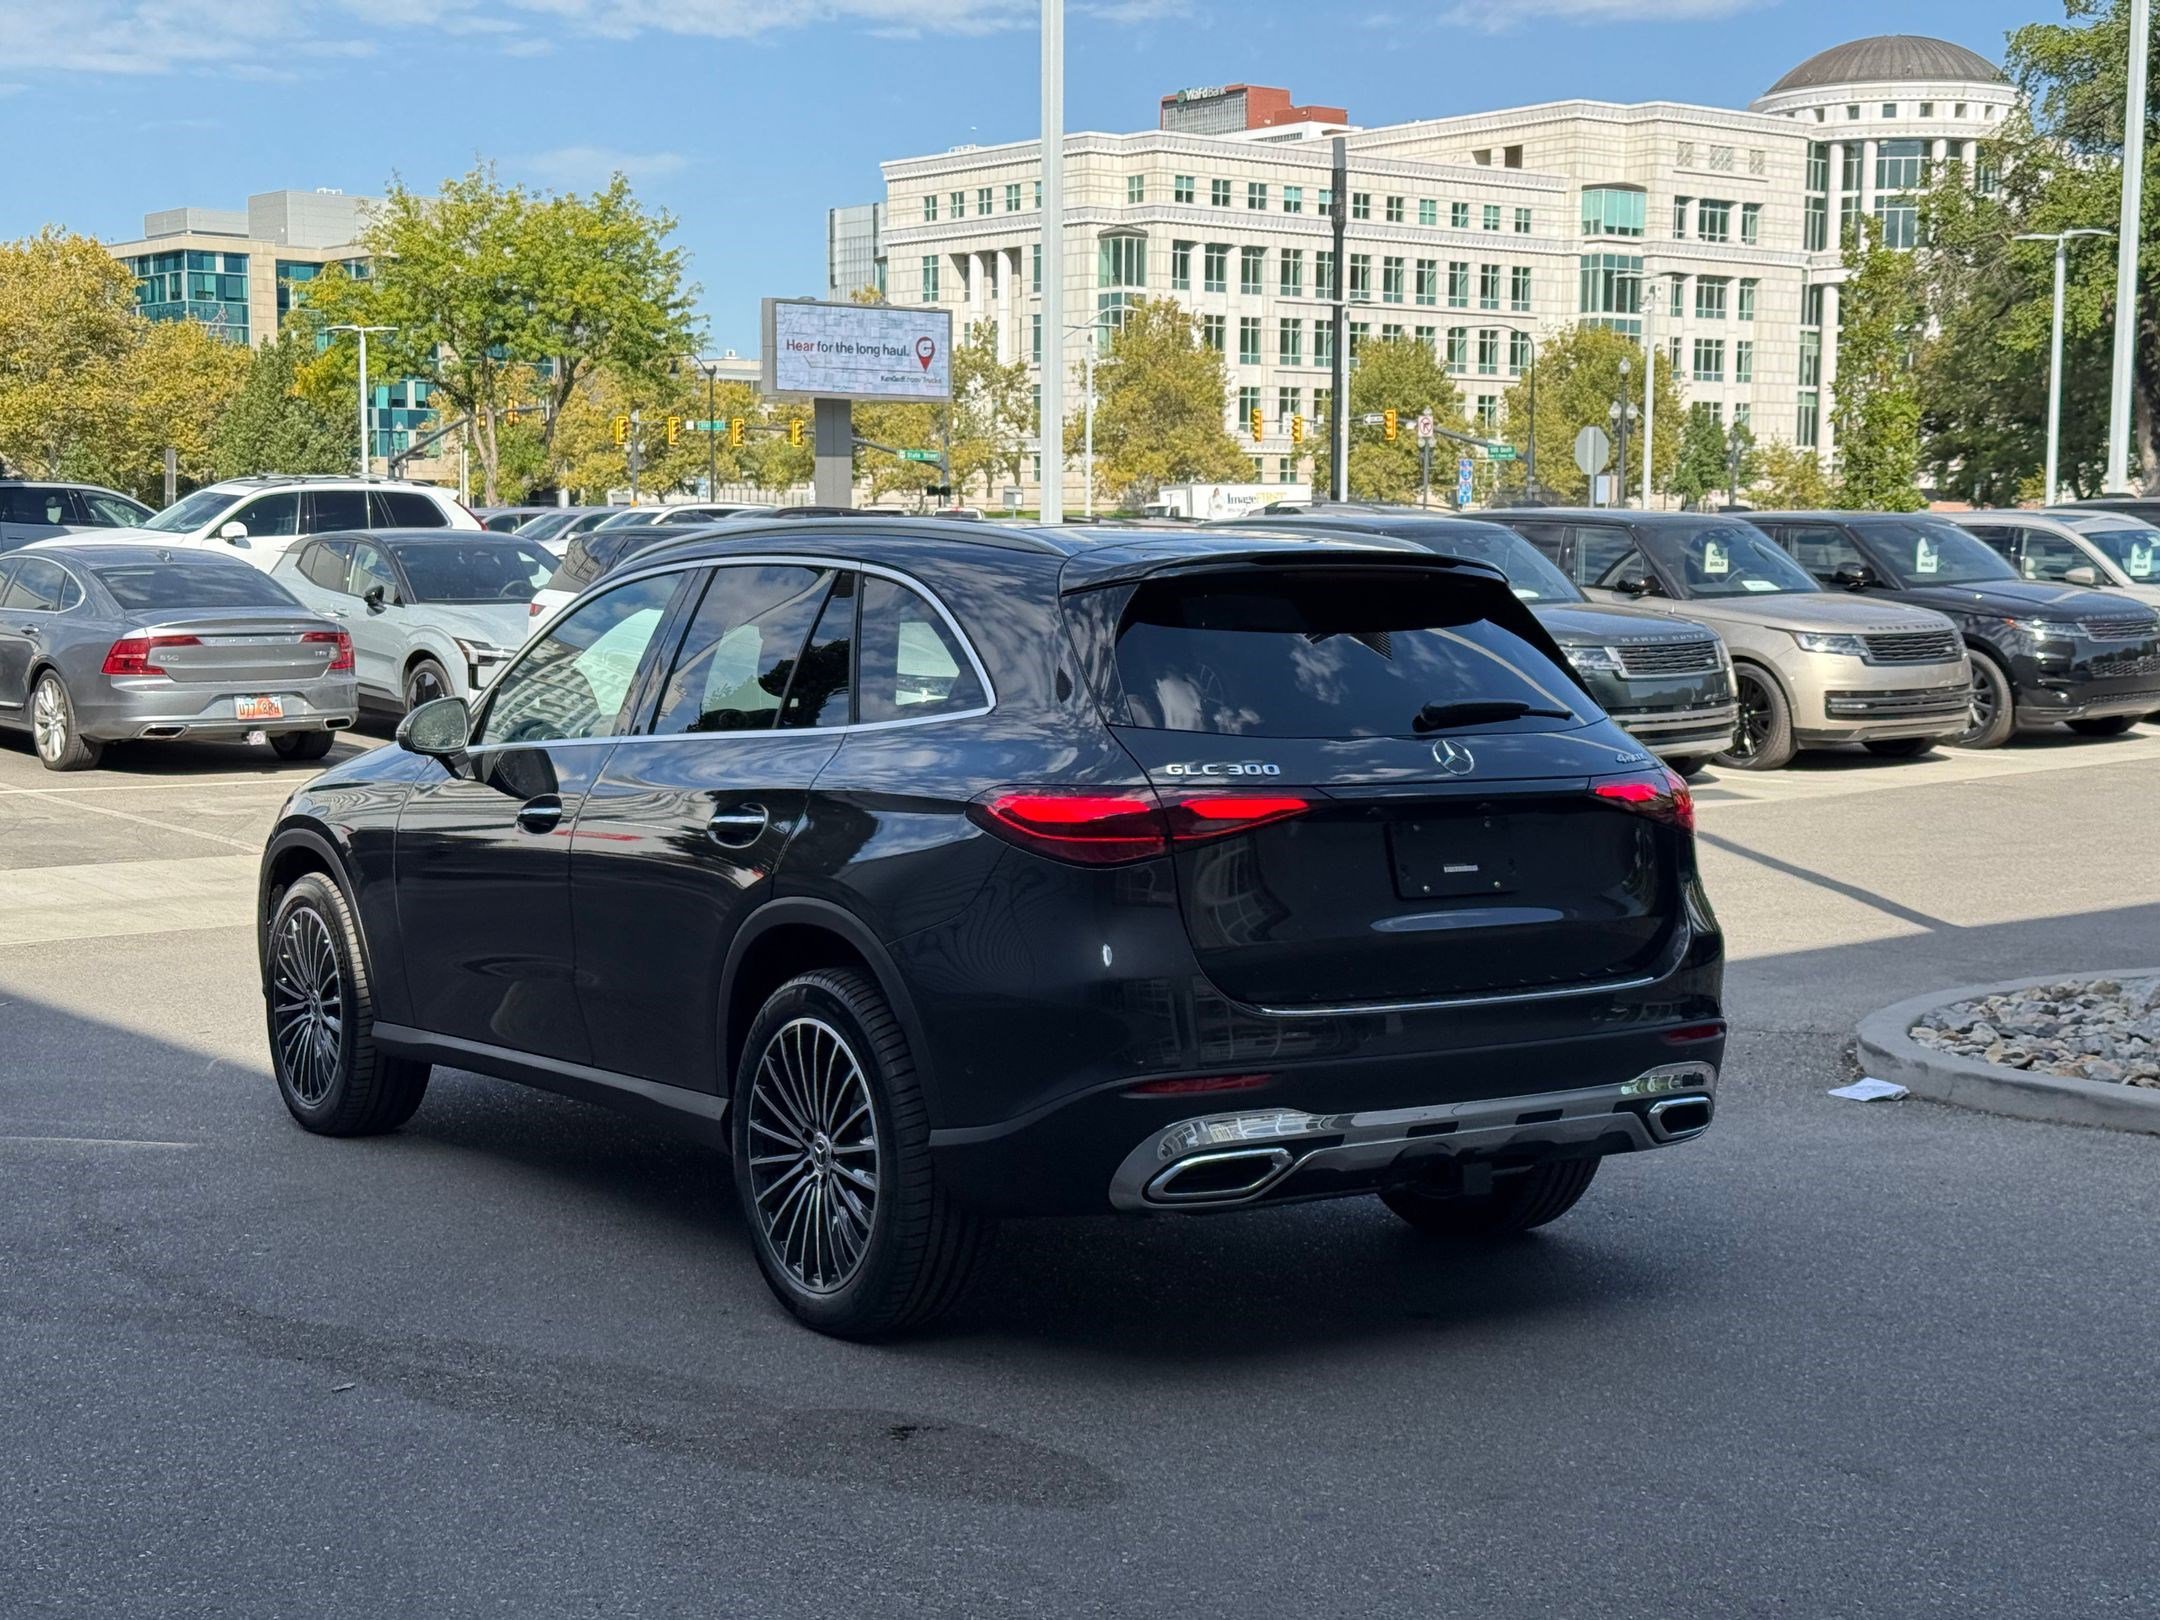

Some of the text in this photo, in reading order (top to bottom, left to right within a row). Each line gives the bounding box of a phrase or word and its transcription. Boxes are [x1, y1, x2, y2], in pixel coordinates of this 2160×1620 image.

[1186, 87, 1208, 101] WaFd
[786, 339, 910, 358] Hear for the long haul.
[1165, 763, 1281, 776] GLC 300
